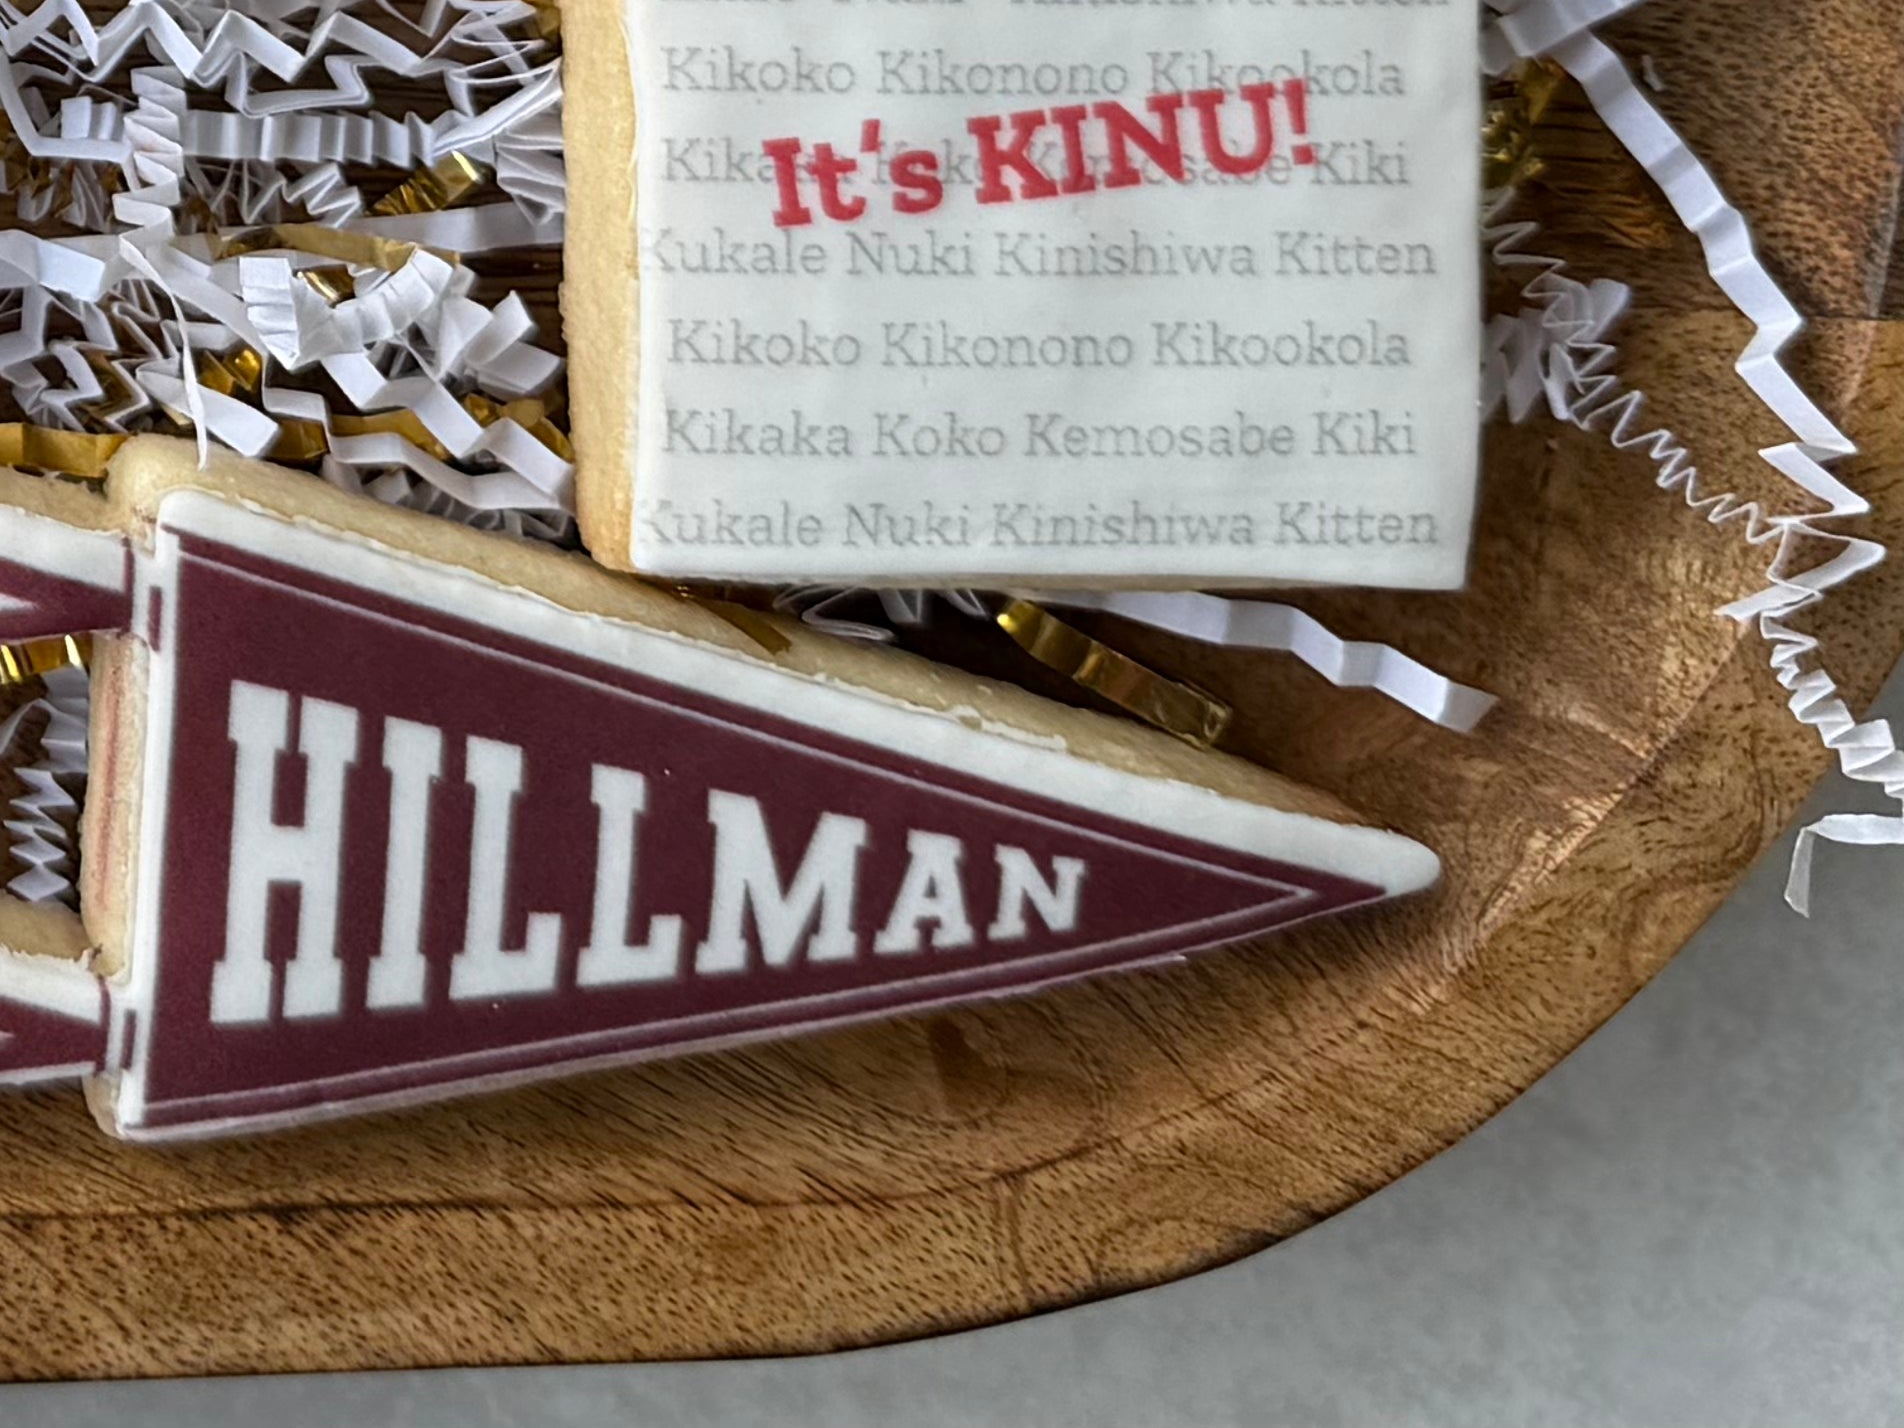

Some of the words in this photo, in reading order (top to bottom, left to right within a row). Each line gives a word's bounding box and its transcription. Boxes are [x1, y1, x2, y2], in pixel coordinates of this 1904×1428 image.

[662, 46, 856, 94] Kikoko
[876, 49, 1128, 96] Kikonono
[1147, 49, 1406, 96] Kikookola
[762, 118, 944, 228] It's
[966, 78, 1316, 204] KINU!
[1311, 141, 1409, 186] Kiki
[846, 230, 976, 276] Nuki
[993, 229, 1259, 276] Kinishiwa
[1273, 231, 1438, 276] Kitten
[667, 318, 861, 366] Kikoko
[881, 320, 1134, 367] Kikonono
[1151, 319, 1412, 366] Kikookola
[664, 408, 853, 456] Kikaka
[872, 411, 1006, 457] Koko
[1024, 411, 1295, 457] Kemosabe
[1312, 410, 1417, 455] Kiki
[843, 500, 970, 546] Nuki
[991, 500, 1255, 546] Kinishiwa
[1274, 501, 1439, 546] Kitten
[208, 679, 1088, 1024] HILLMAN
